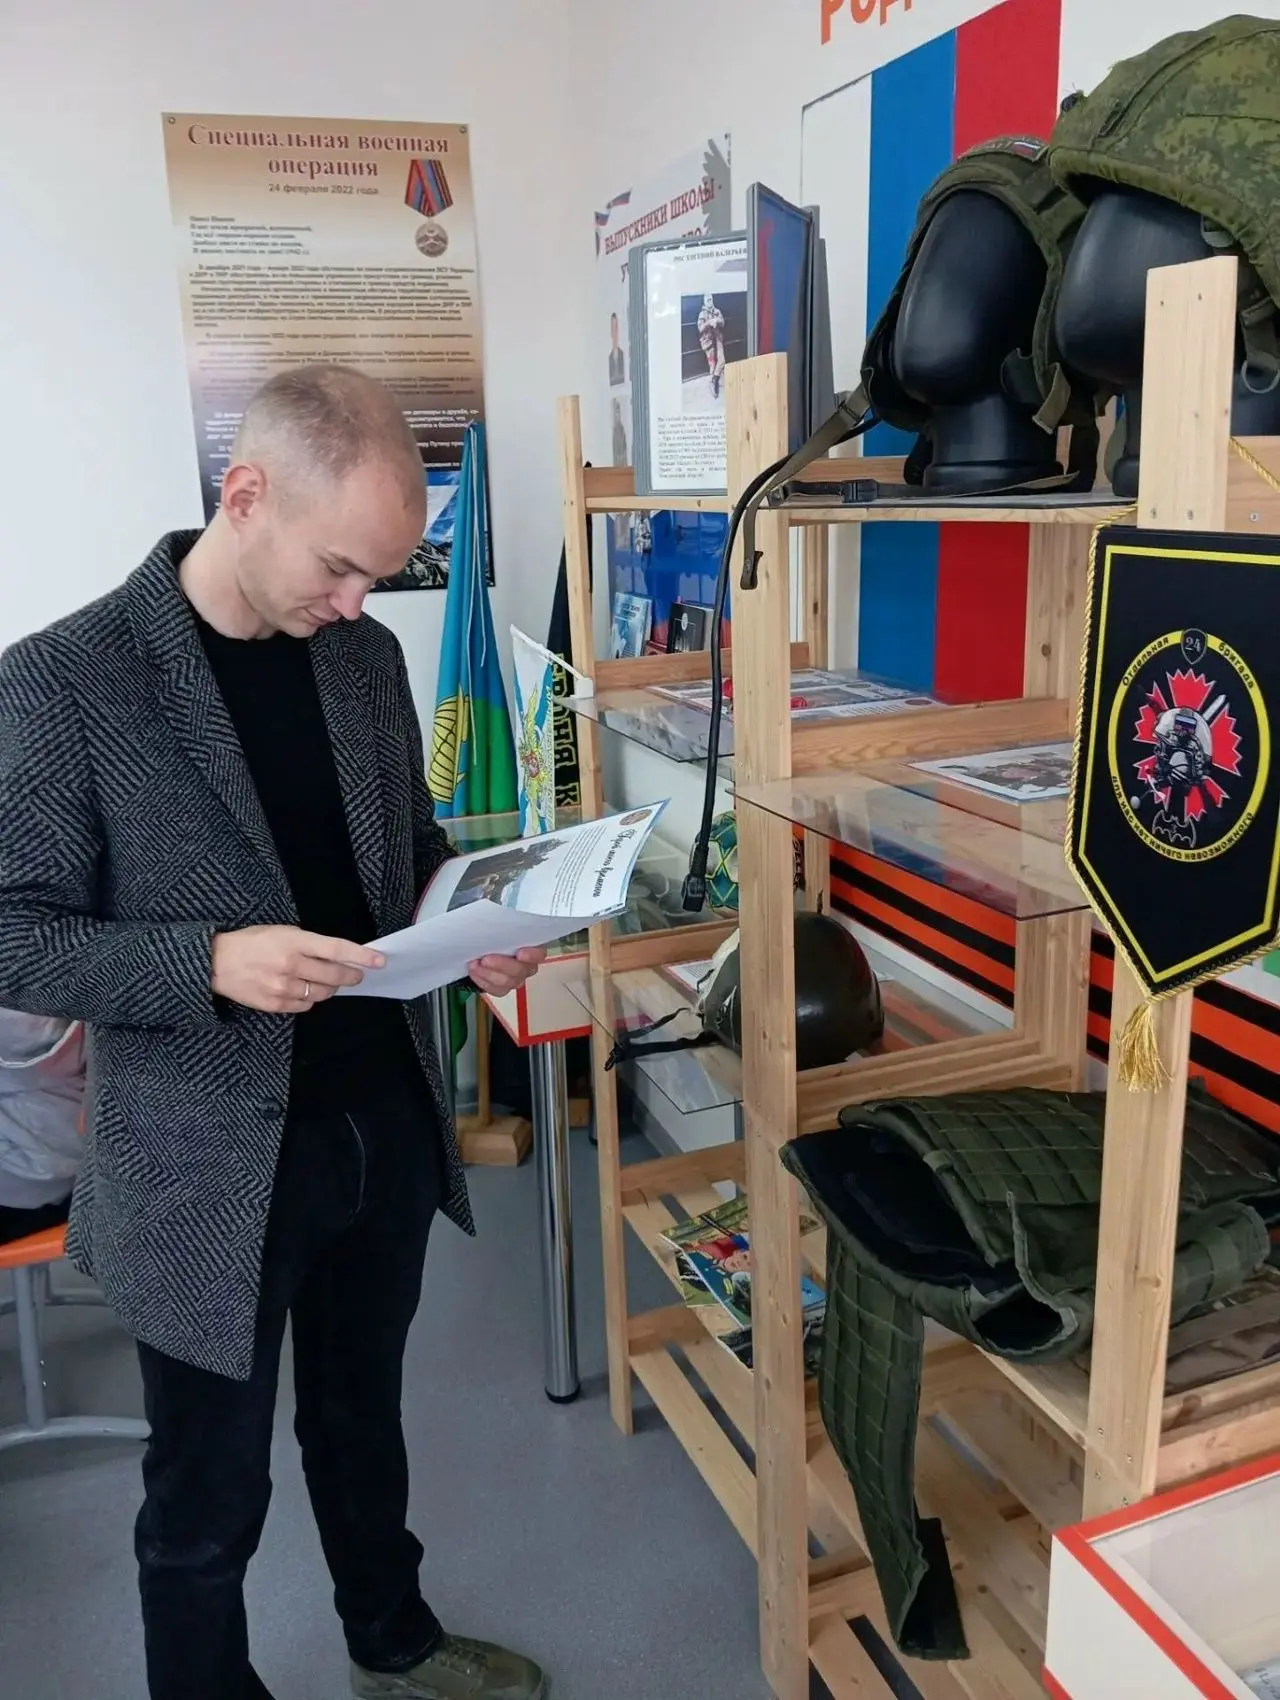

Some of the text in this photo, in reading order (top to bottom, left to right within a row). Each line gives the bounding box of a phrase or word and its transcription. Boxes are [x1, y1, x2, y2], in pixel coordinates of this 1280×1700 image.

[188, 124, 449, 153] Специальная военная
[268, 158, 378, 179] операция
[268, 183, 379, 196] 24 февраля 2022 года
[604, 177, 715, 255] ВЫПУСКНИКИ ШКОЛЫ
[1185, 636, 1201, 652] 24
